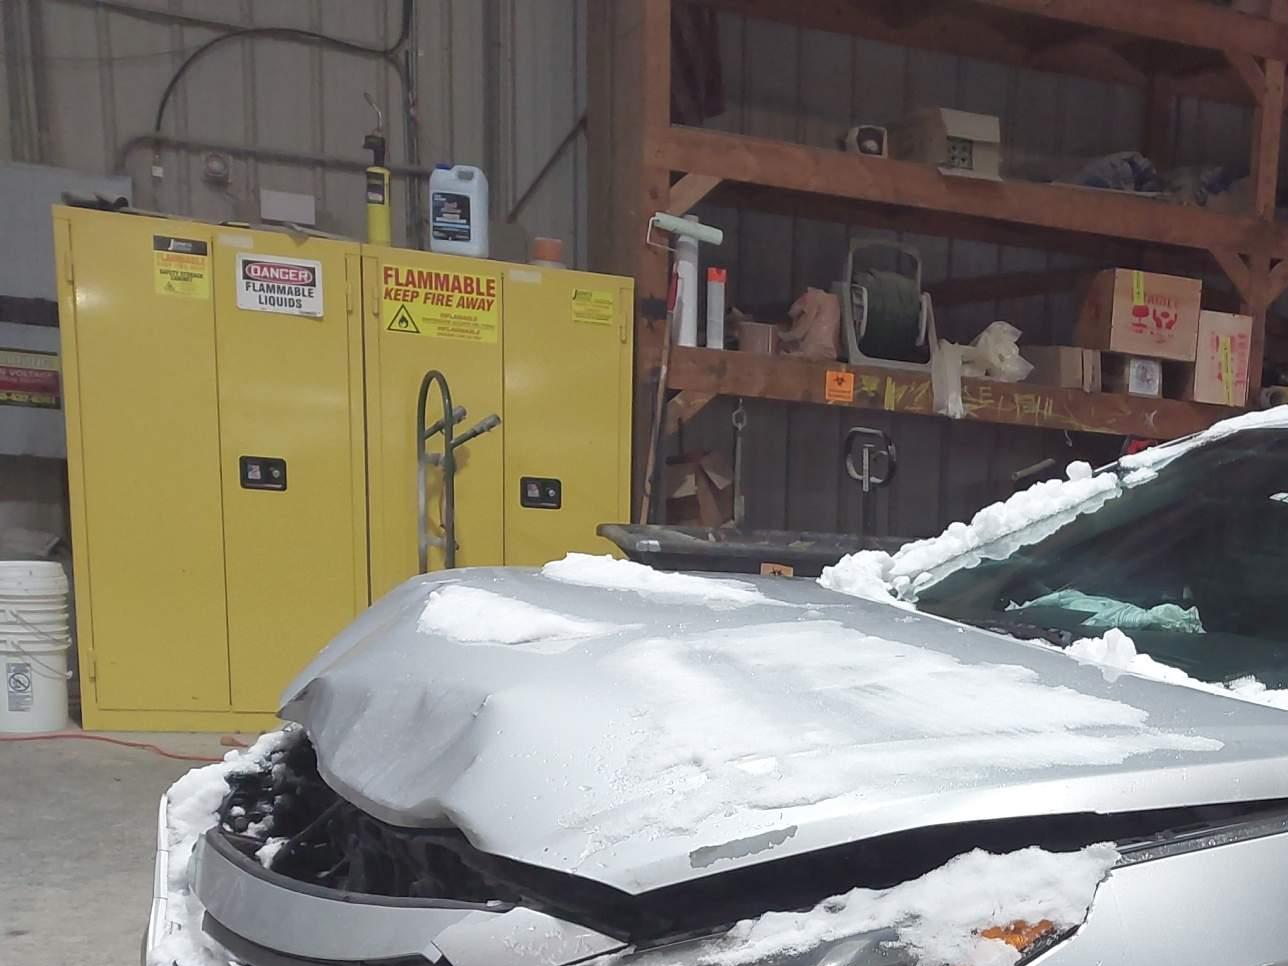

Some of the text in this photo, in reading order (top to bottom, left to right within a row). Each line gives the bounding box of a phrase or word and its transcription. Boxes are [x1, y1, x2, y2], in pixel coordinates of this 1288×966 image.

[250, 265, 308, 281] DANGER
[383, 266, 496, 297] FLAMMABLE
[245, 281, 315, 298] FLAMMABLE
[258, 294, 303, 309] LIQUIDS
[383, 287, 495, 312] KEEP FIRE AWAY
